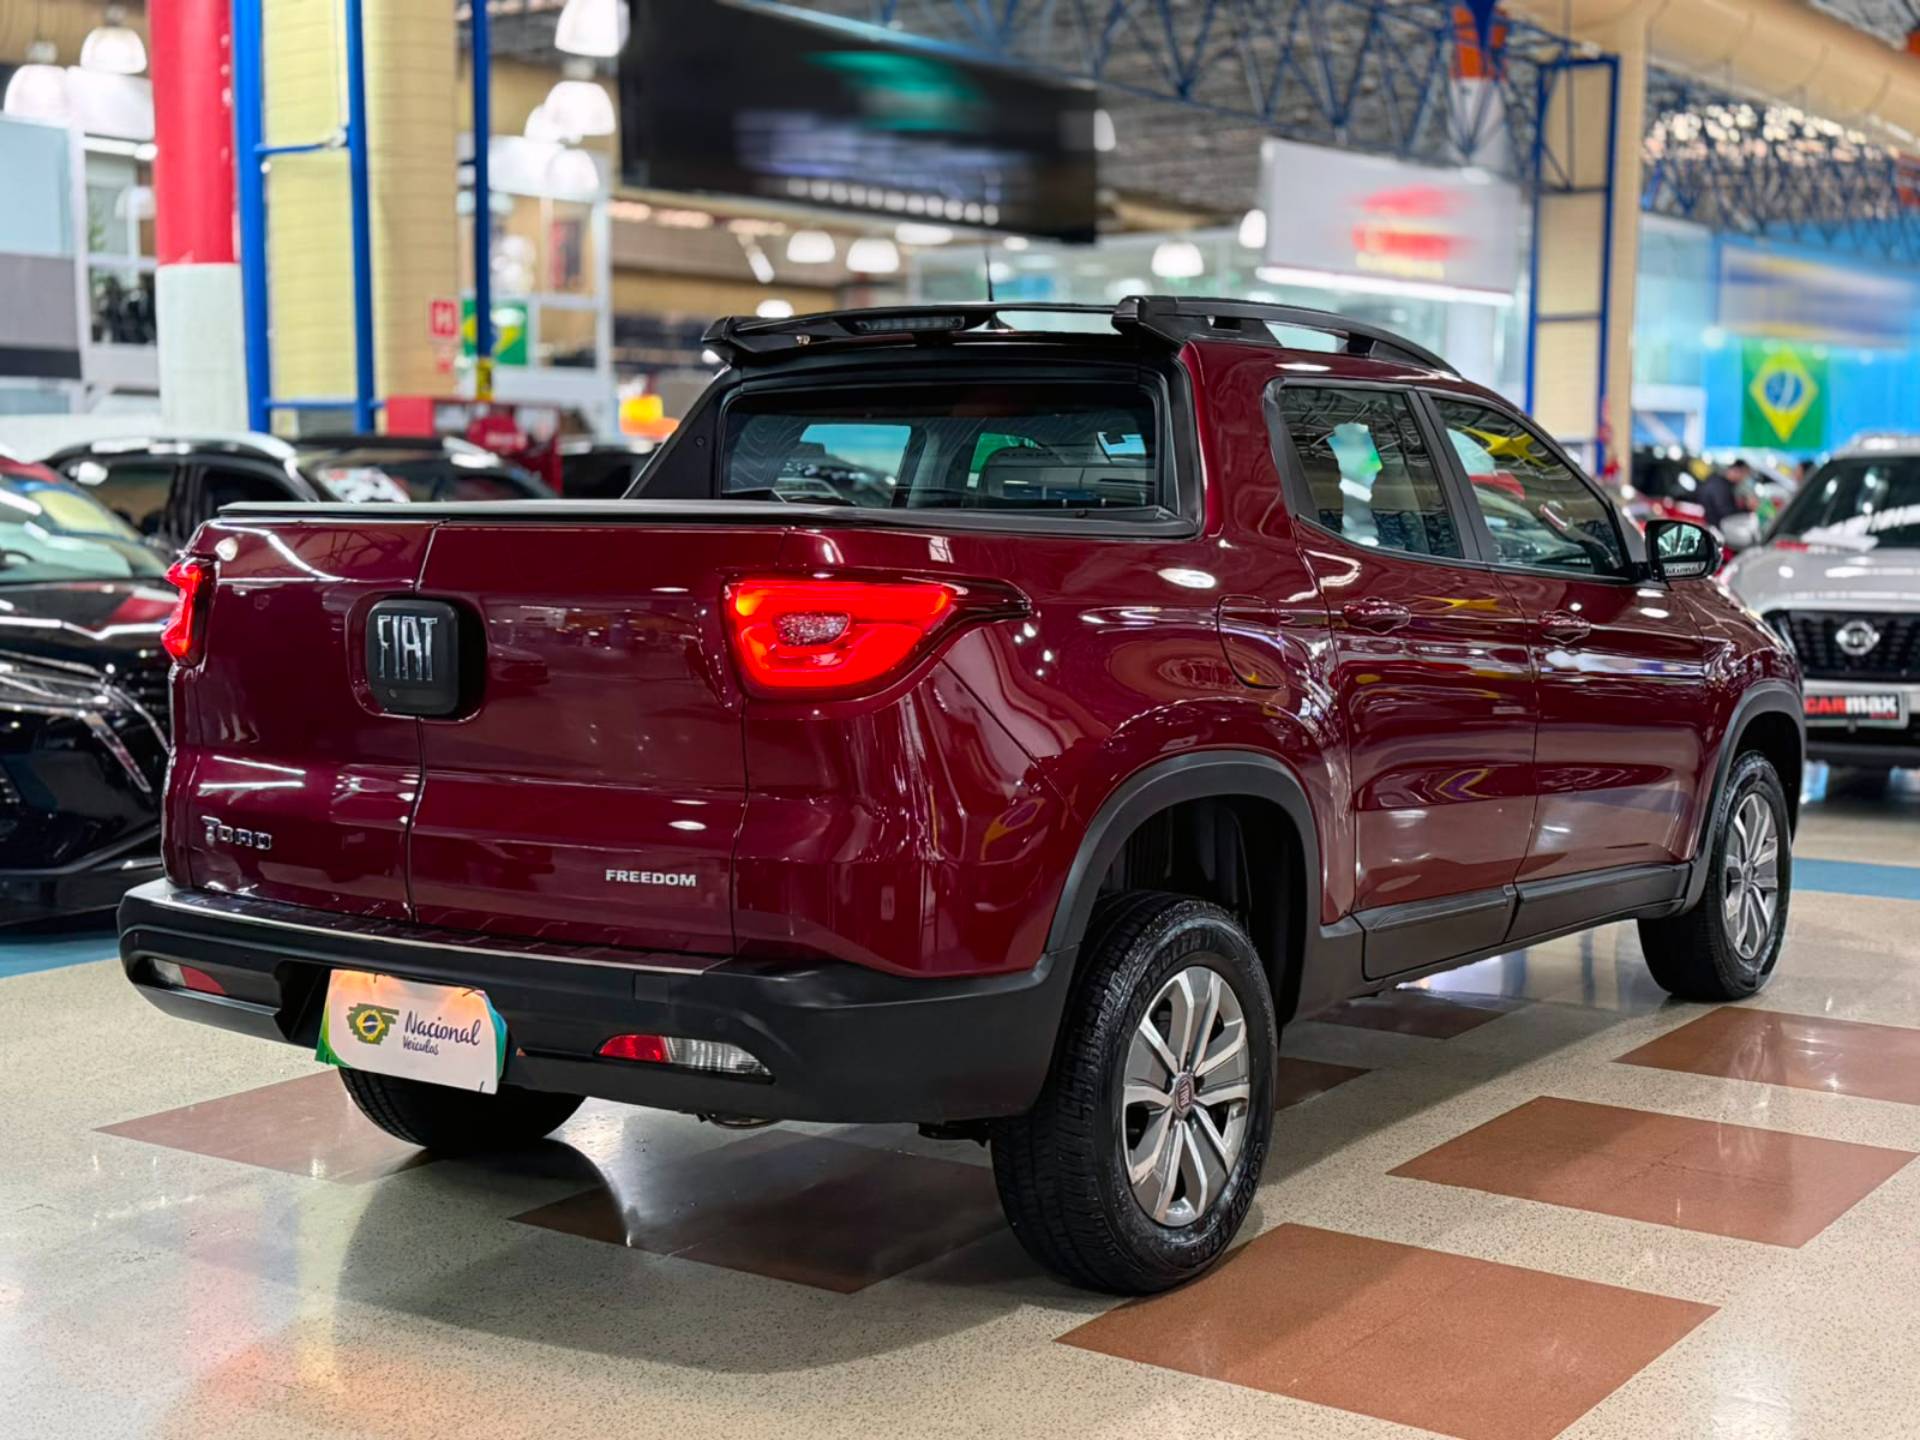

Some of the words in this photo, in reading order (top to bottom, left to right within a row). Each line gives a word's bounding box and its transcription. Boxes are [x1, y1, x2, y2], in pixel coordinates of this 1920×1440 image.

[378, 615, 438, 681] FIAT
[605, 869, 697, 887] FREEDOM
[405, 1011, 481, 1046] Nacional
